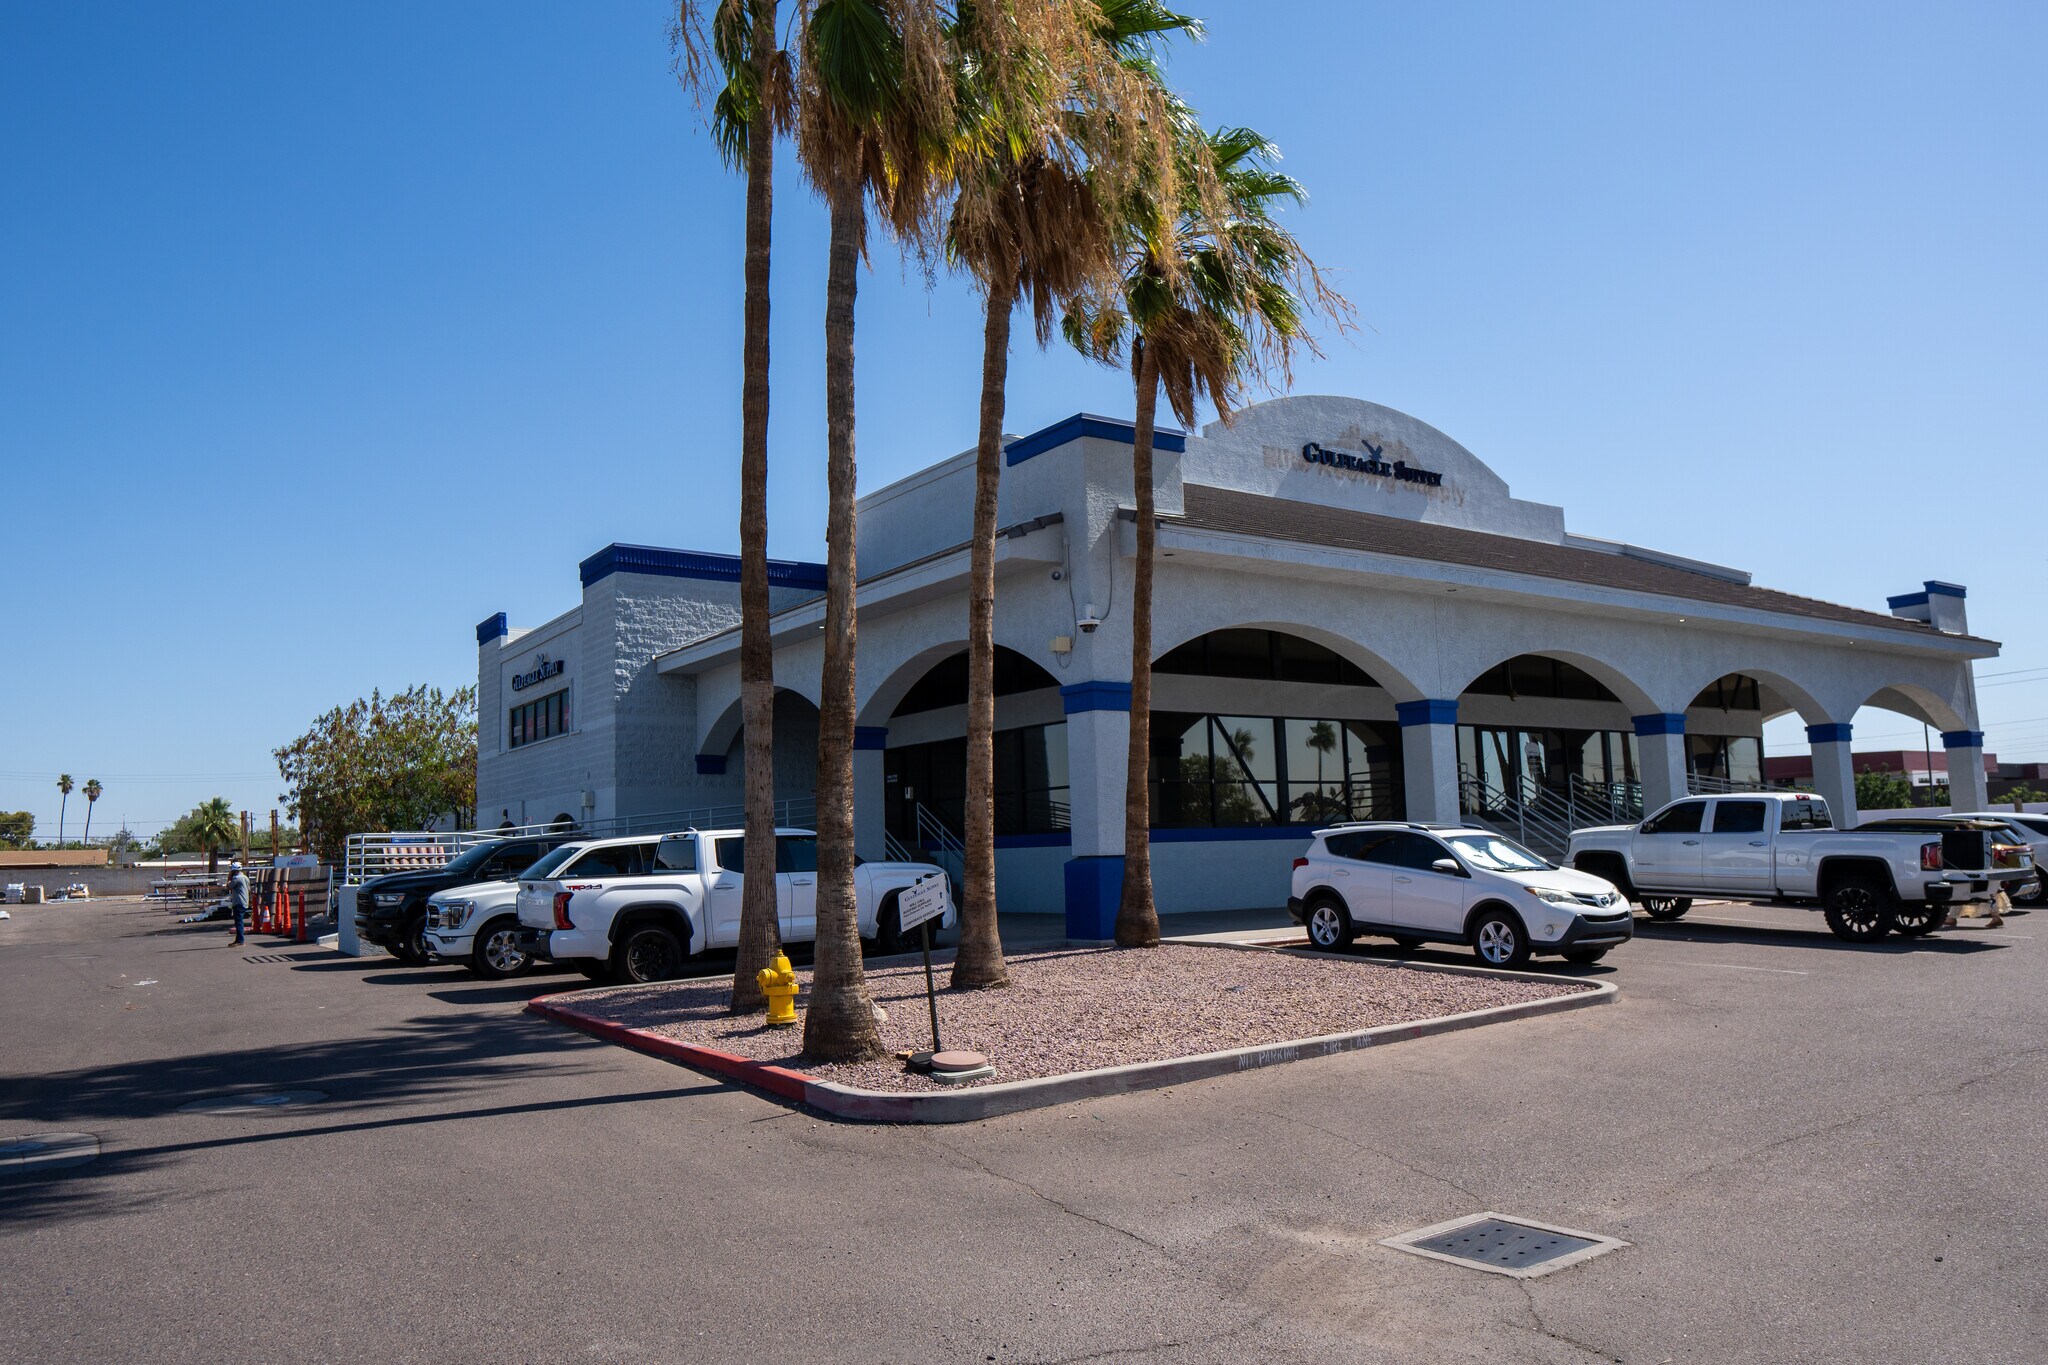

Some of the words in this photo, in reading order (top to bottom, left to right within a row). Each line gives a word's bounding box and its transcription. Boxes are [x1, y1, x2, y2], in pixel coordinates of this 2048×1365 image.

[1238, 1054, 1253, 1070] NO
[1258, 1046, 1300, 1067] PARKING
[1323, 1039, 1345, 1056] FIRE
[1349, 1034, 1372, 1051] LANE
